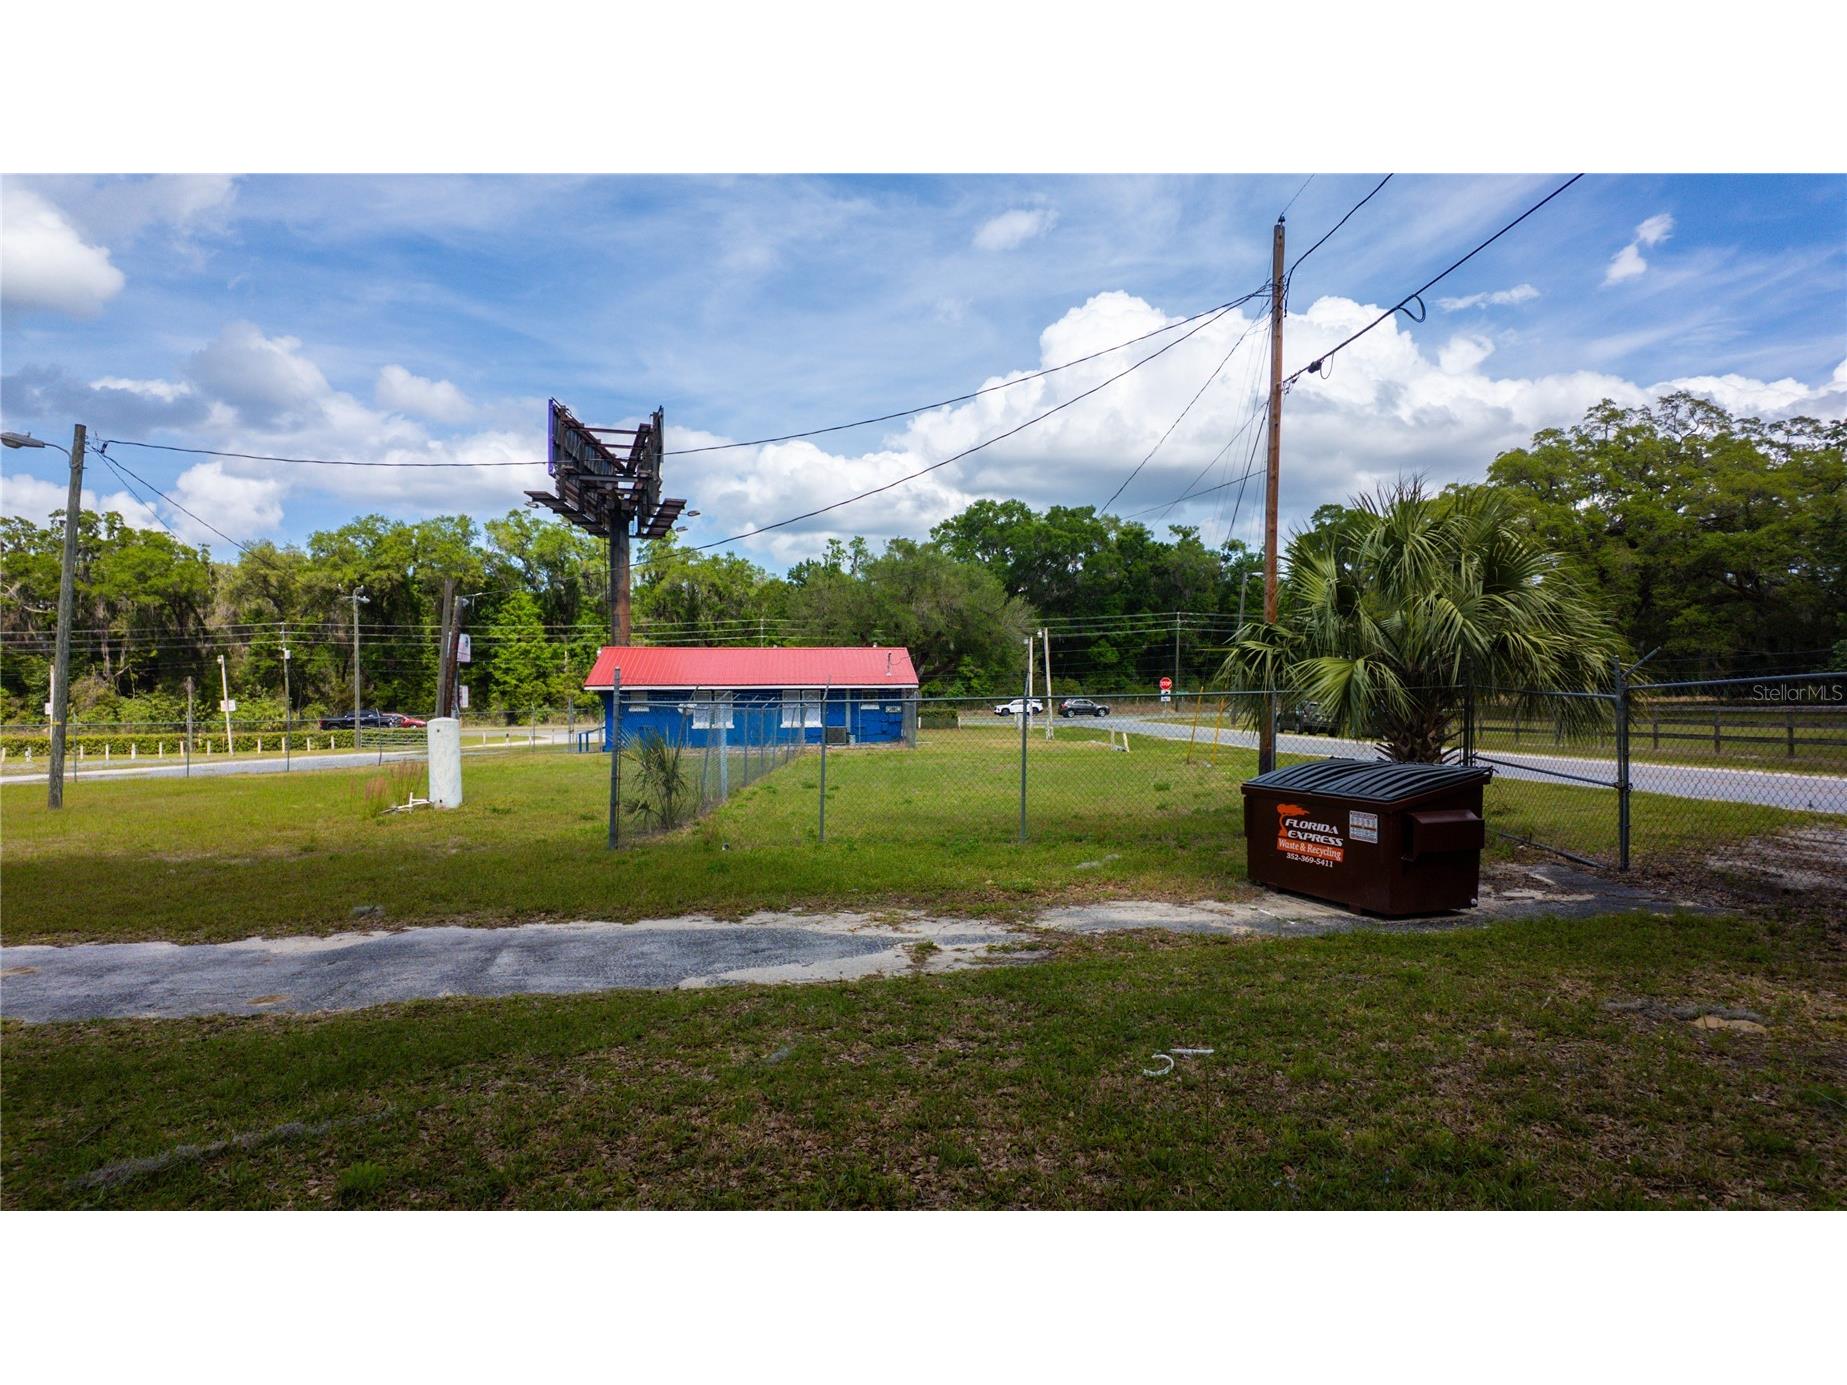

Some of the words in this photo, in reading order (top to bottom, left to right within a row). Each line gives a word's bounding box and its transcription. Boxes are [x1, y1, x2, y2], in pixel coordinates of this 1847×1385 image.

[1285, 819, 1338, 834] FLORIDA
[1288, 830, 1343, 846] EXPRESS
[1279, 838, 1299, 850] Waste
[1300, 843, 1306, 852] &
[1307, 844, 1342, 861] Recycling
[1286, 852, 1333, 867] 352-369-5411
